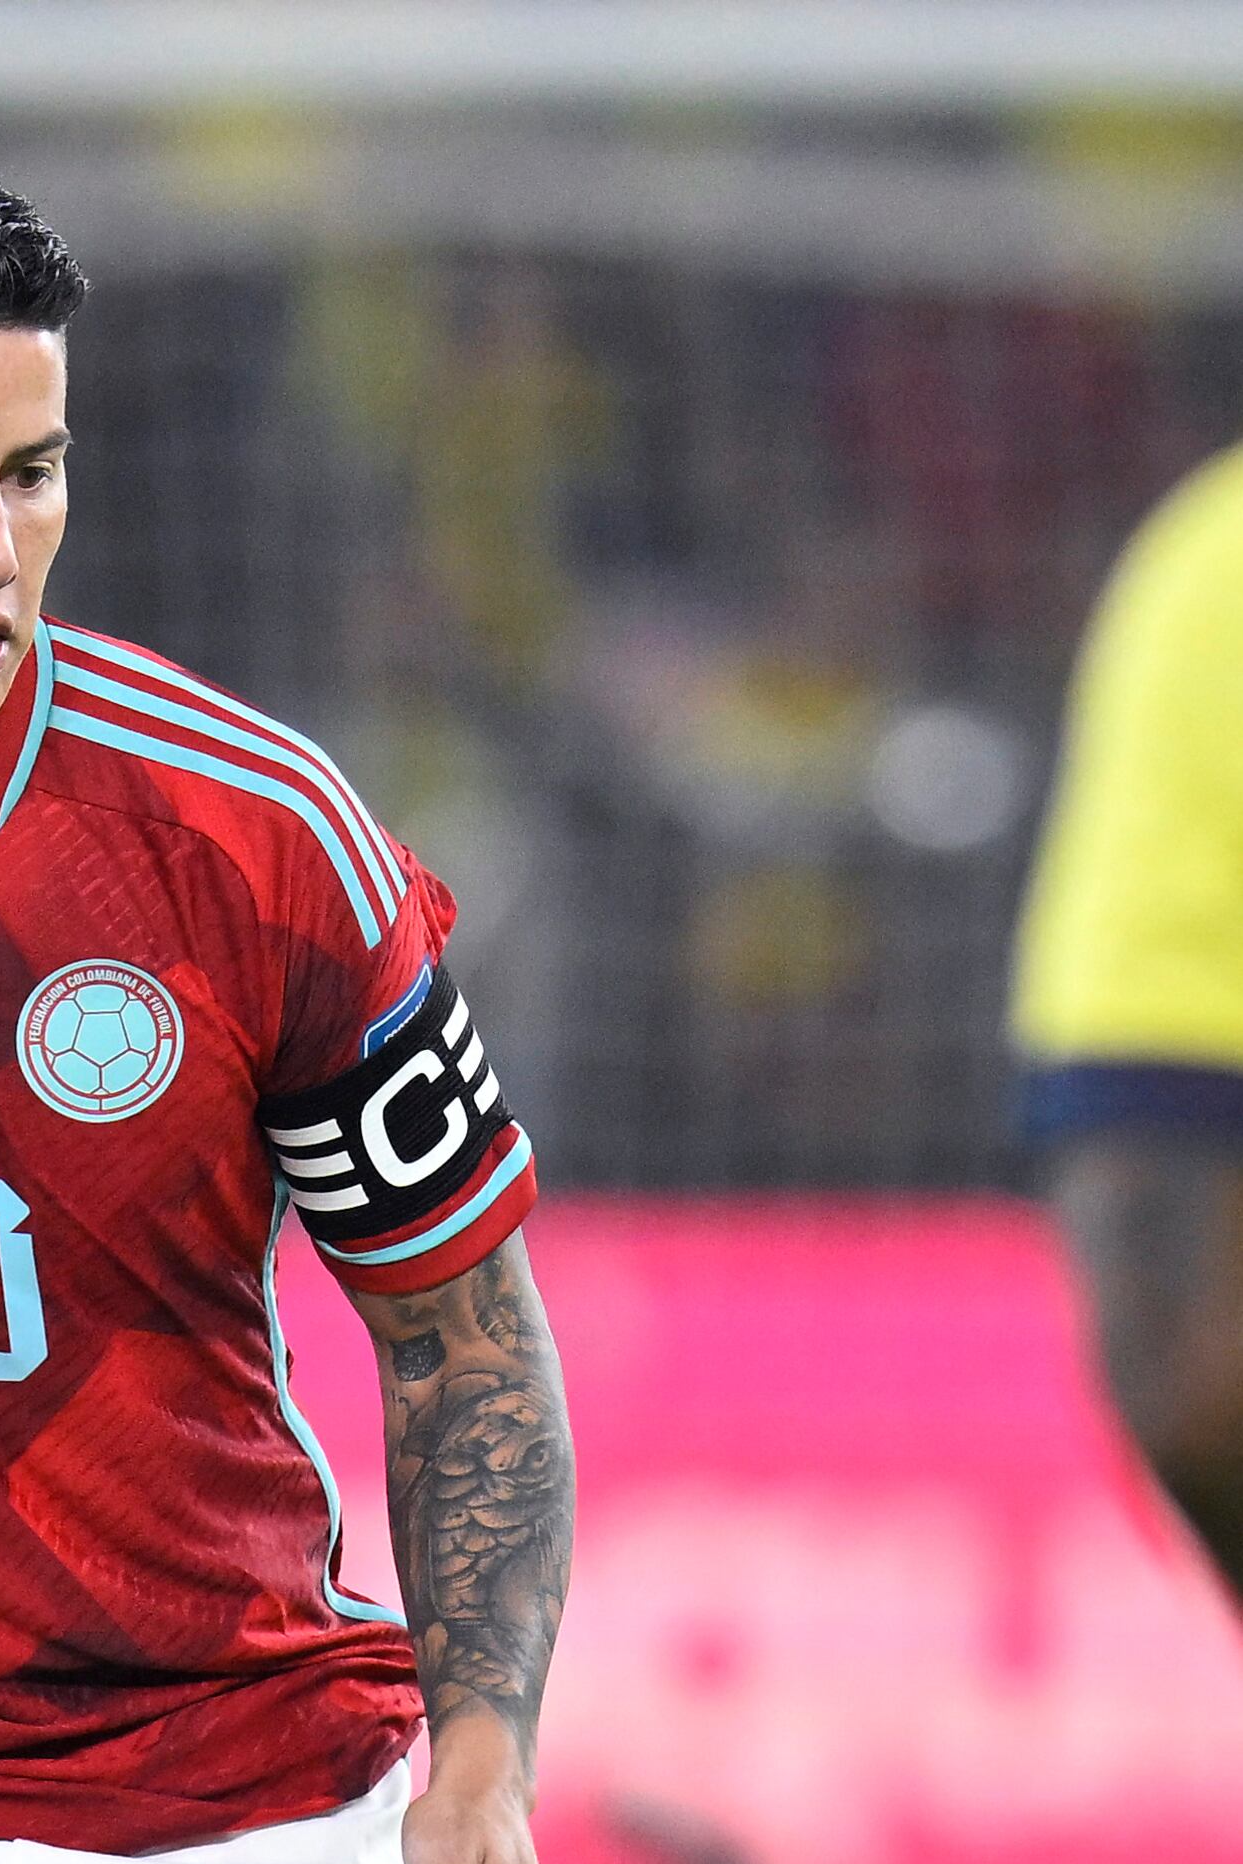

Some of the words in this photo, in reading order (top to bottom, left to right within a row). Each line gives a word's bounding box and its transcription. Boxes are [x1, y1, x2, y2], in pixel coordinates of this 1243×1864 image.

[28, 981, 68, 1042] FEDERACION
[66, 968, 139, 990] COLOMBIANA
[136, 983, 154, 1000] DE
[148, 996, 172, 1037] FUTBOL
[360, 1048, 469, 1188] C
